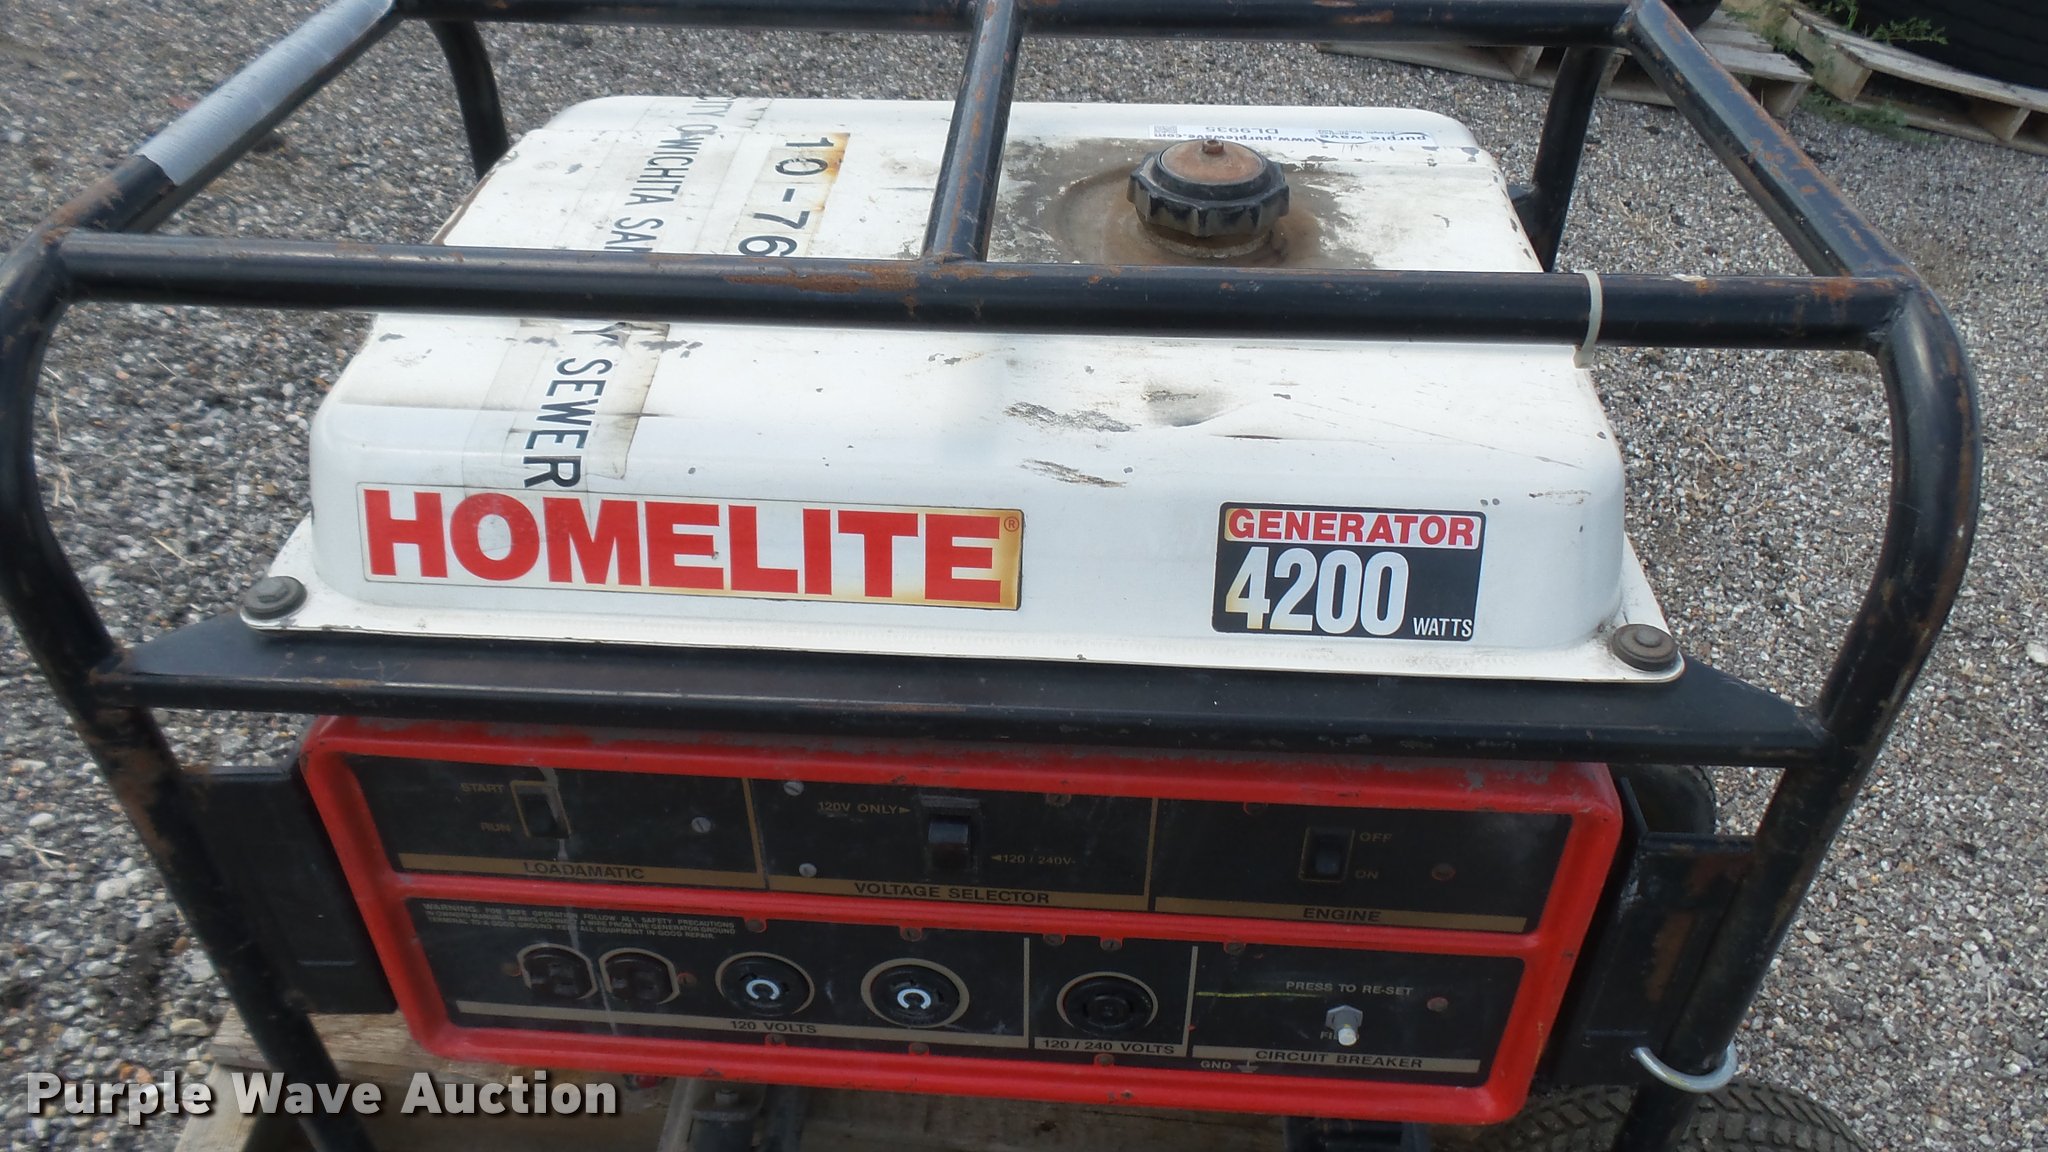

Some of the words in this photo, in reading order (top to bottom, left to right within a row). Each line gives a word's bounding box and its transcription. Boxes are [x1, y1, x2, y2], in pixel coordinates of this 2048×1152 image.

[686, 96, 738, 118] ITY
[1154, 132, 1316, 143] www.purplewave.com
[1371, 134, 1427, 142] purple
[625, 137, 704, 206] WICHITA
[738, 137, 834, 257] 10-76
[524, 357, 613, 489] SEWER
[1228, 508, 1475, 546] GENERATOR
[364, 489, 1002, 604] HOMELITE
[1225, 546, 1409, 636] 4200
[1413, 616, 1473, 638] WATTS
[459, 782, 504, 793] START
[817, 800, 851, 813] 120V
[857, 802, 898, 815] ONLY
[1359, 831, 1392, 842] OFF
[1003, 854, 1026, 864] 120
[523, 861, 645, 880] LOADAMATIC
[1355, 869, 1379, 880] ON
[853, 881, 941, 900] VOLTAGE
[949, 886, 1050, 905] SELECTOR
[583, 913, 616, 922] FOLLOW
[621, 915, 635, 923] ALL
[641, 916, 672, 924] SAFETY
[678, 918, 735, 929] PRECAUTIONS
[1303, 907, 1382, 922] ENGINE
[580, 925, 593, 934] ALL
[596, 926, 644, 936] EQUIPMENT
[657, 930, 683, 938] GOOD
[608, 921, 632, 929] FROM
[700, 925, 736, 935] GROUND
[1285, 980, 1334, 992] PRESS
[1338, 983, 1357, 993] TO
[1362, 984, 1414, 997] RE-SET
[730, 1020, 757, 1030] 120
[763, 1022, 817, 1034] VOLTS
[1043, 1039, 1070, 1050] 120
[1084, 1040, 1113, 1051] 240
[1120, 1042, 1175, 1055] VOLTS
[1200, 1060, 1232, 1070] GND
[1255, 1050, 1329, 1063] CIRCUIT
[1336, 1054, 1423, 1069] BREAKER
